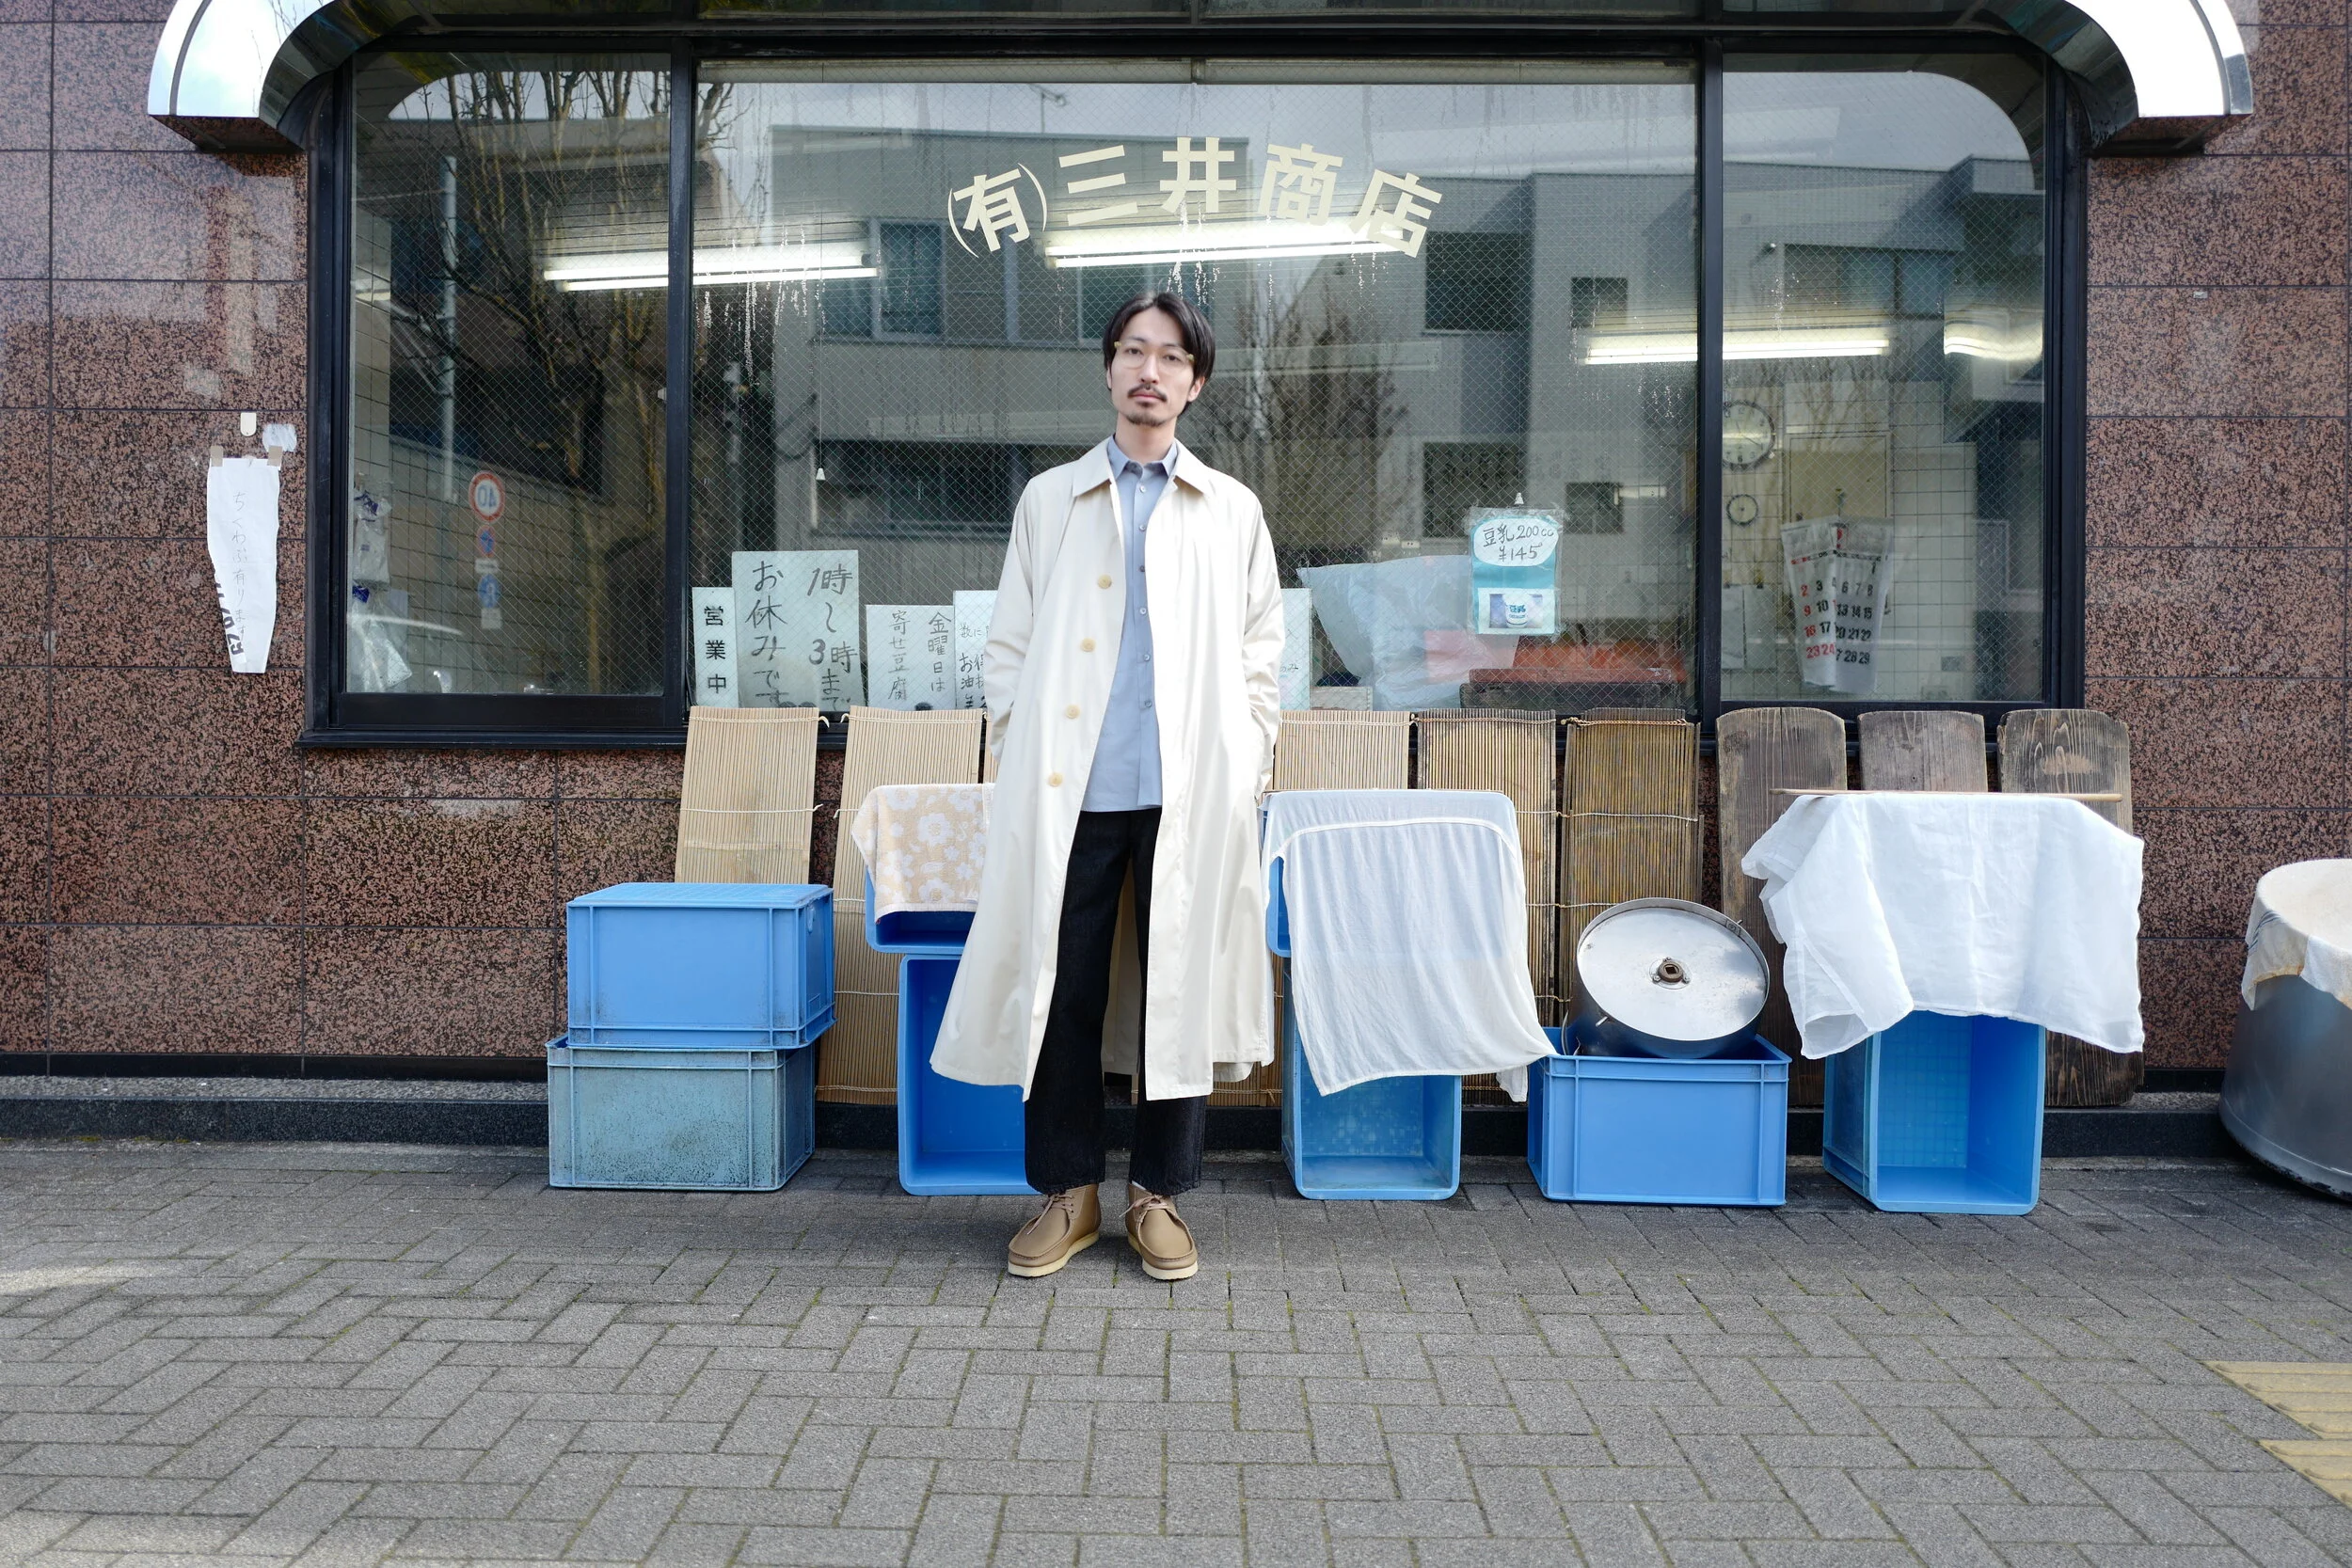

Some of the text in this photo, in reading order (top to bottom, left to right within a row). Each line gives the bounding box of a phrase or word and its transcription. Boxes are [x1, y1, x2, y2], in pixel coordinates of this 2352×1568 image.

[230, 491, 247, 641] ちくわぶ有ります
[1801, 583, 1809, 597] 2
[1816, 579, 1823, 592] 3
[1841, 581, 1849, 594] 6
[1856, 582, 1862, 595] 7
[1867, 583, 1874, 596] 8
[745, 561, 789, 707] お休みです
[960, 623, 990, 639] 数に
[1804, 604, 1812, 617] 9
[1816, 599, 1829, 612] 10
[1837, 603, 1849, 616] 13
[1851, 604, 1861, 618] 14
[1864, 607, 1872, 620] 15
[1804, 625, 1816, 638] 16
[1820, 621, 1831, 633] 17
[1848, 626, 1859, 640] 21
[704, 605, 726, 694] 営業中
[887, 610, 911, 701] 寄せ豆腐
[927, 611, 951, 692] 金曜日は
[1806, 645, 1820, 659] 23
[1844, 650, 1857, 663] 28
[1859, 652, 1870, 665] 29
